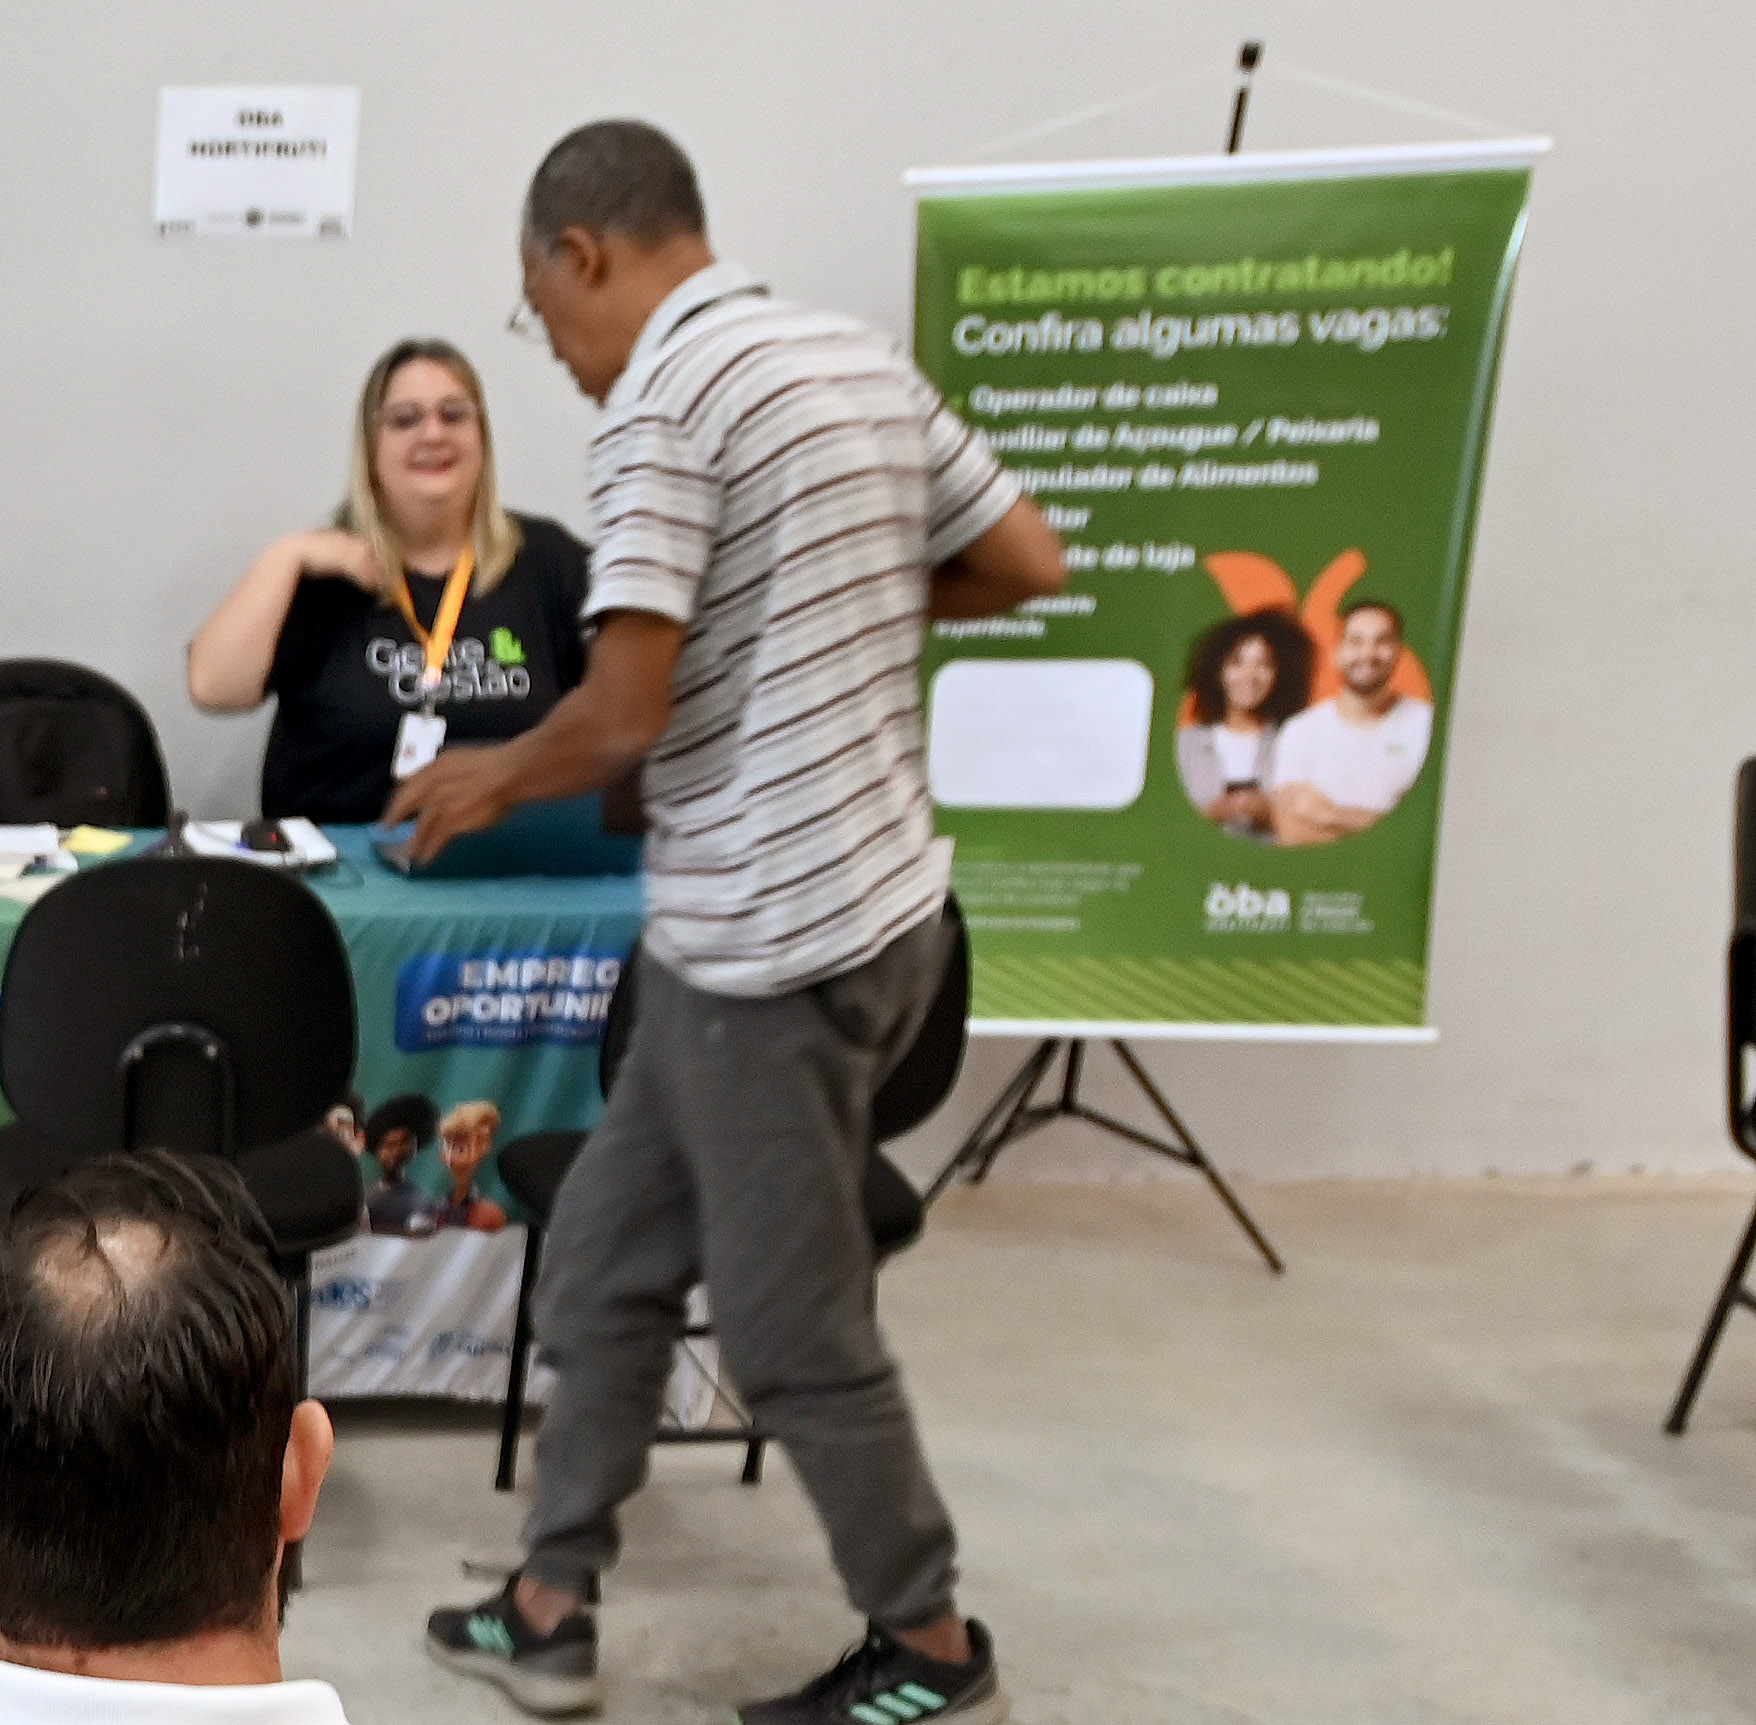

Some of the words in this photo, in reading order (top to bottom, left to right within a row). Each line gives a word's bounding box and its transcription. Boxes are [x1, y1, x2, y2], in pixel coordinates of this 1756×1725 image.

[958, 264, 1147, 303] Estamos
[1153, 246, 1456, 298] contratando!
[952, 311, 1104, 357] Confira
[1109, 306, 1301, 360] algumas
[1307, 304, 1451, 352] vagas:
[970, 384, 1097, 418] Operador
[1101, 382, 1141, 410] de
